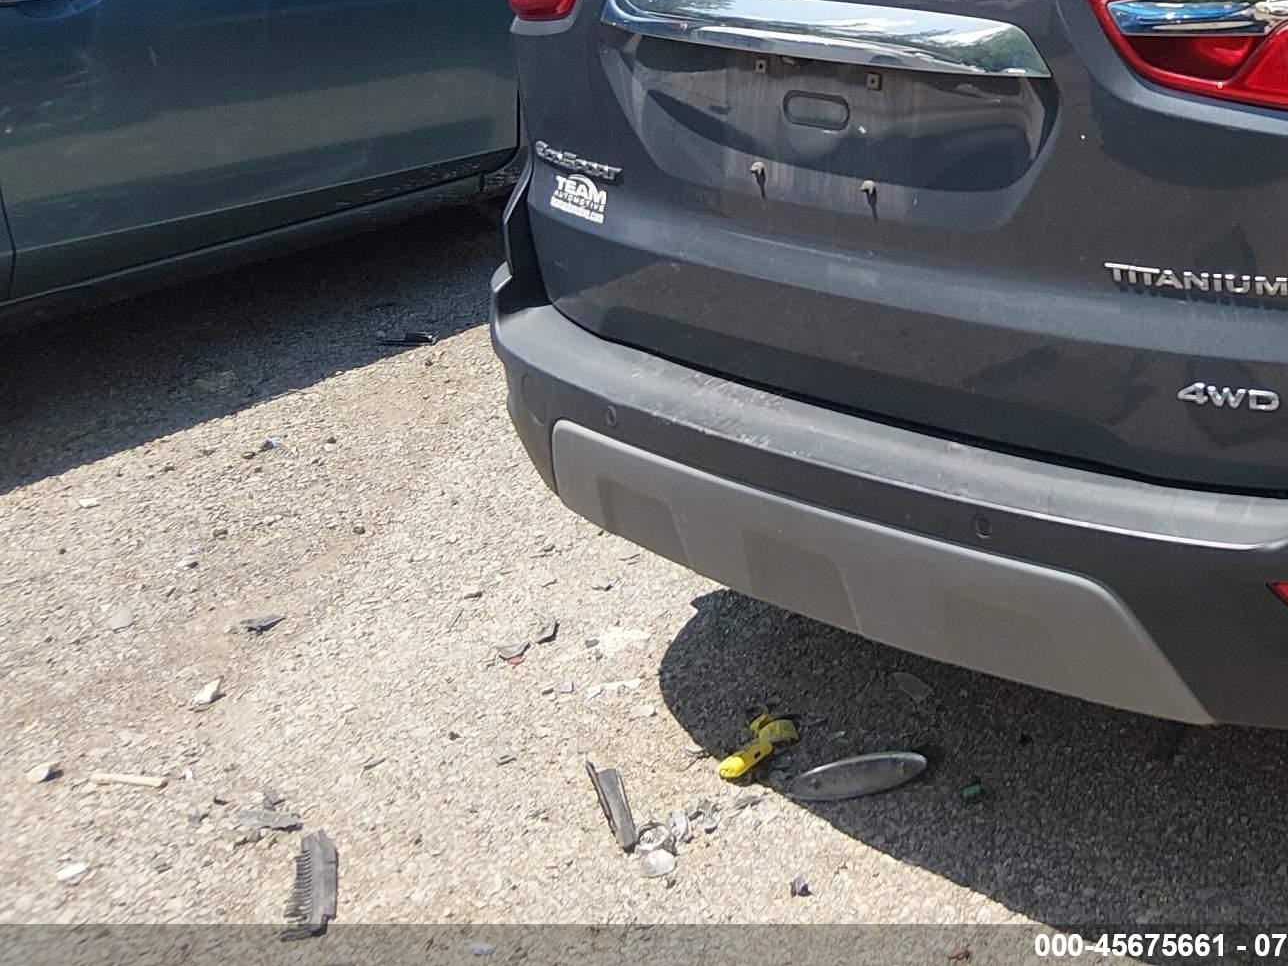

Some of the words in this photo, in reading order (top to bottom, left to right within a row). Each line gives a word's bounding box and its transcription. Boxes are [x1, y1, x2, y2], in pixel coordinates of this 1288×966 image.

[553, 190, 605, 213] AUTOMOTIVE
[556, 175, 607, 205] TEAM
[1104, 262, 1288, 297] TITANIUM
[1177, 382, 1280, 411] 4WD
